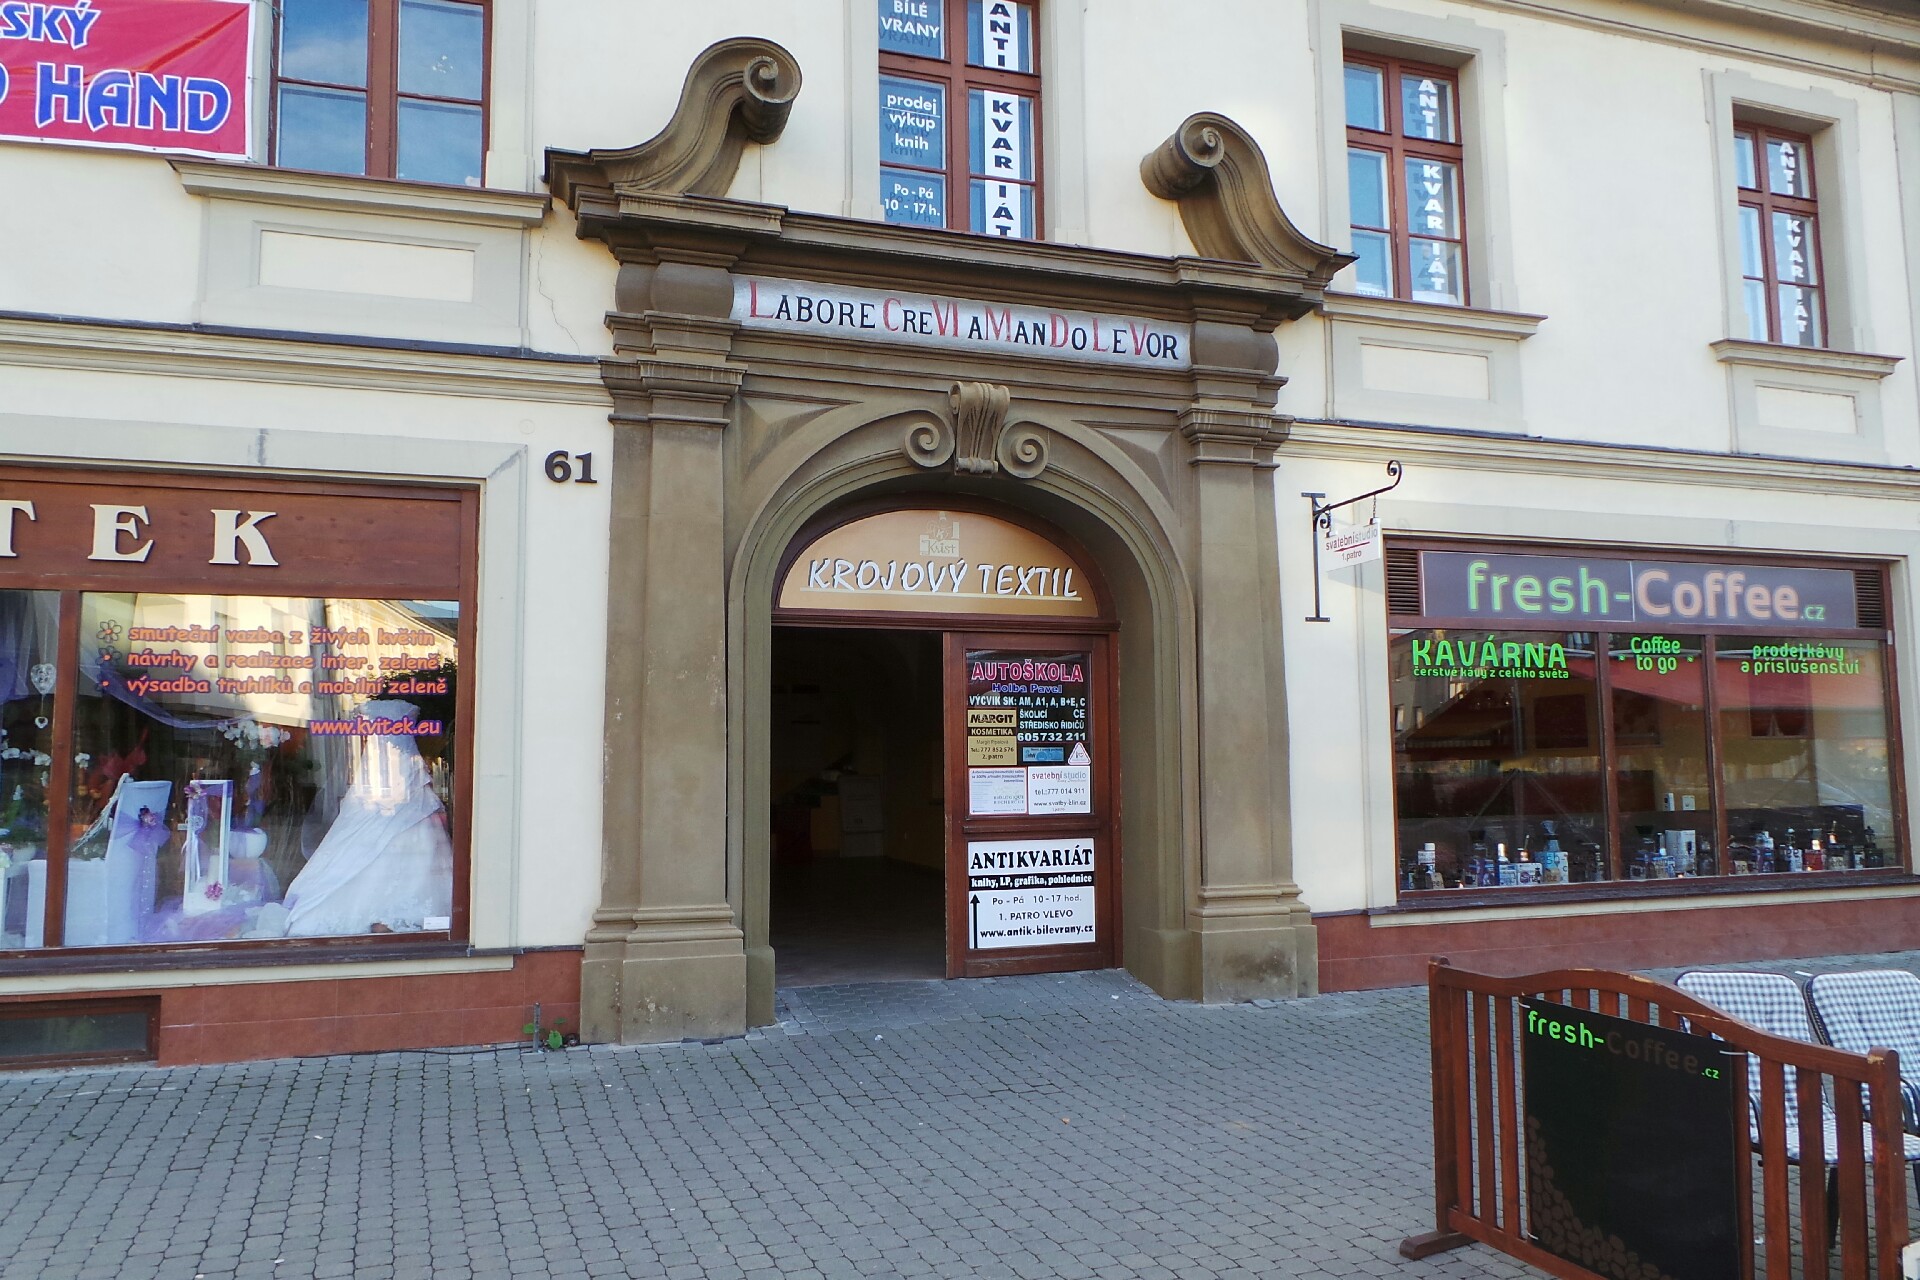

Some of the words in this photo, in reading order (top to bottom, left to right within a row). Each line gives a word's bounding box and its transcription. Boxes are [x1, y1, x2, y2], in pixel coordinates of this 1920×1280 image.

[893, 0, 928, 18] BÍLÉ
[880, 16, 940, 38] VRANY
[35, 61, 231, 134] HAND
[887, 93, 937, 115] prodej
[889, 113, 936, 132] výkup
[895, 134, 929, 150] knih
[894, 183, 909, 196] Po
[918, 184, 934, 199] Pá
[884, 198, 899, 211] 10
[913, 202, 927, 214] 17
[928, 203, 940, 217] h.
[545, 450, 598, 484] 61
[808, 558, 969, 593] KROJOVÝ
[976, 564, 1078, 599] TEXTIL
[128, 624, 220, 644] smuteční
[225, 626, 285, 644] vazba
[288, 629, 303, 645] z
[310, 625, 370, 649] živých
[376, 627, 437, 646] květin
[1630, 635, 1682, 656] Coffee
[127, 651, 198, 672] návrhy
[204, 655, 219, 669] a
[225, 652, 315, 670] realizace
[321, 653, 374, 671] inter.
[379, 653, 440, 671] zeleně
[1412, 635, 1568, 669] KAVÁRNA
[1752, 642, 1803, 661] prodej
[1806, 643, 1845, 662] kávy
[971, 659, 1084, 682] AUTOŠKOLA
[1413, 666, 1458, 677] čerstvé
[1461, 667, 1487, 680] kávy
[1499, 667, 1536, 678] celého
[1635, 655, 1654, 672] to
[1656, 656, 1678, 674] go
[1740, 661, 1750, 674] a
[1753, 656, 1861, 676] příslušenství
[127, 674, 210, 697] výsadba
[217, 675, 293, 695] truhlíků
[297, 680, 312, 695] a
[317, 677, 384, 695] mobilní
[387, 678, 447, 695] zeleně
[992, 683, 1027, 693] Holba
[1030, 683, 1063, 694] Pavel
[969, 695, 1001, 706] VÝCVIK
[1080, 698, 1086, 707] C
[970, 714, 1014, 724] MARGIT
[1019, 708, 1048, 719] ŠKOLICÍ
[309, 715, 442, 738] www.kvitek.eu
[971, 728, 1014, 736] KOSMETIKA
[1019, 720, 1059, 730] STŘEDISKO
[1065, 732, 1086, 741] 211
[970, 844, 1093, 869] ANTIKVARIÁT
[971, 877, 998, 888] knihy,
[1000, 877, 1013, 887] LP,
[1014, 876, 1047, 888] grafika,
[1048, 874, 1093, 886] pohlednice
[992, 897, 1003, 905] Po
[1013, 896, 1024, 904] Pá
[1064, 894, 1082, 902] hod.
[999, 913, 1007, 921] 1.
[1010, 911, 1040, 920] PATRO
[1043, 909, 1073, 919] VLEVO
